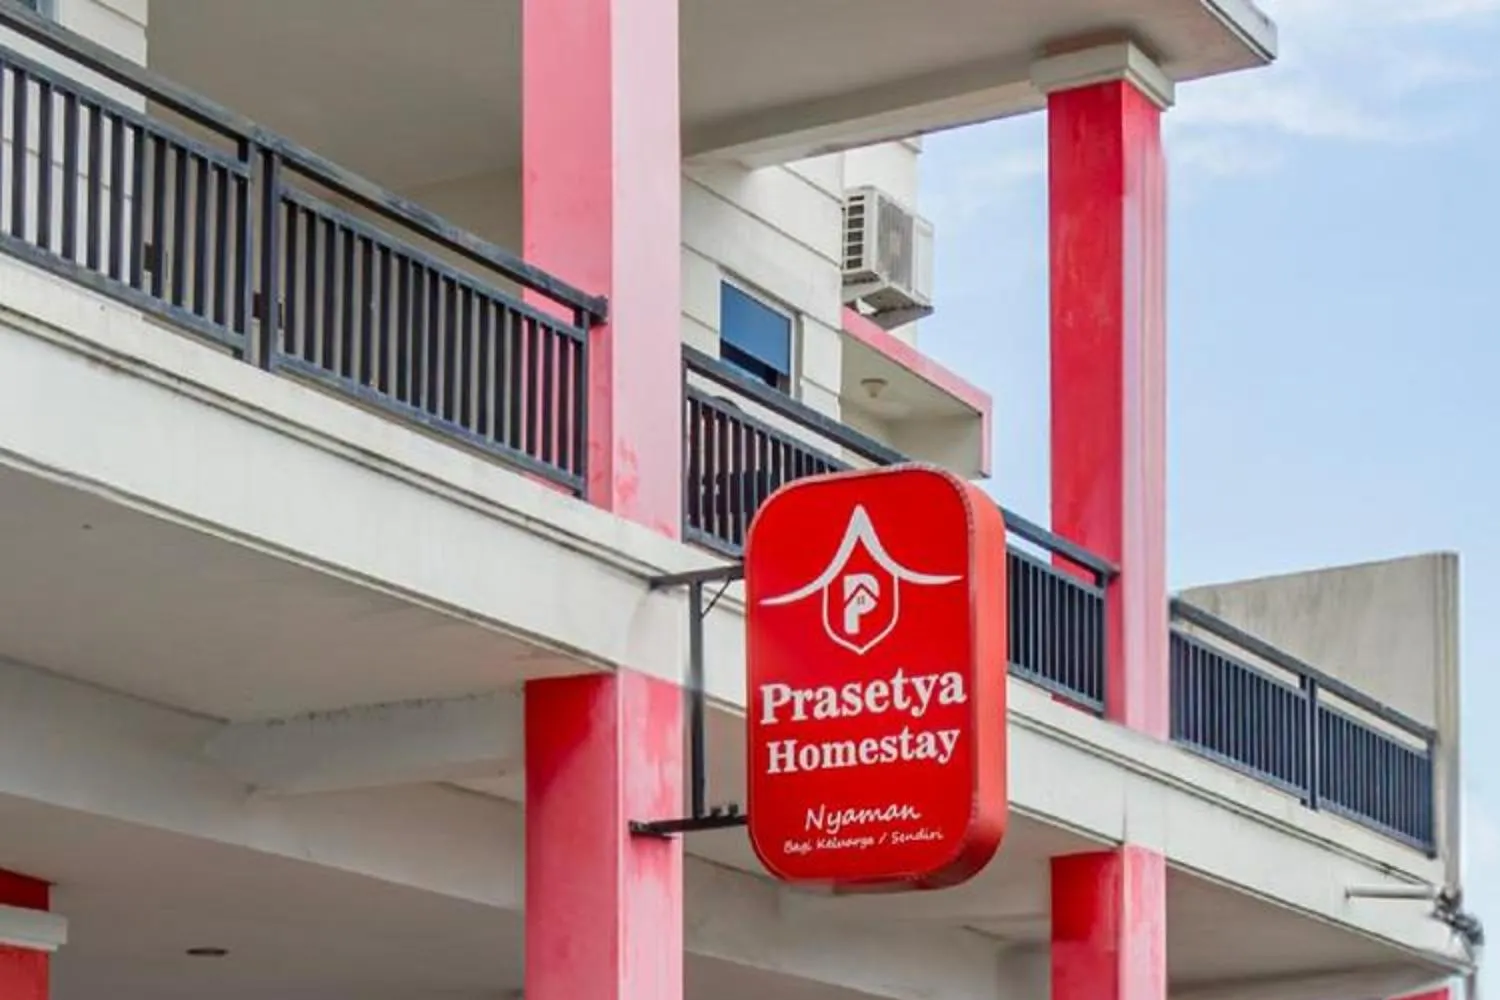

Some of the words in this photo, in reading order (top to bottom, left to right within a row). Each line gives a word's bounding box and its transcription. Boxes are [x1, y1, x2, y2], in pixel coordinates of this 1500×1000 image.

[844, 573, 879, 634] P
[760, 668, 967, 725] Prasetya
[766, 725, 960, 774] Homestay
[805, 804, 921, 834] Nyaman
[878, 832, 888, 845] /
[891, 827, 944, 844] Sendiri
